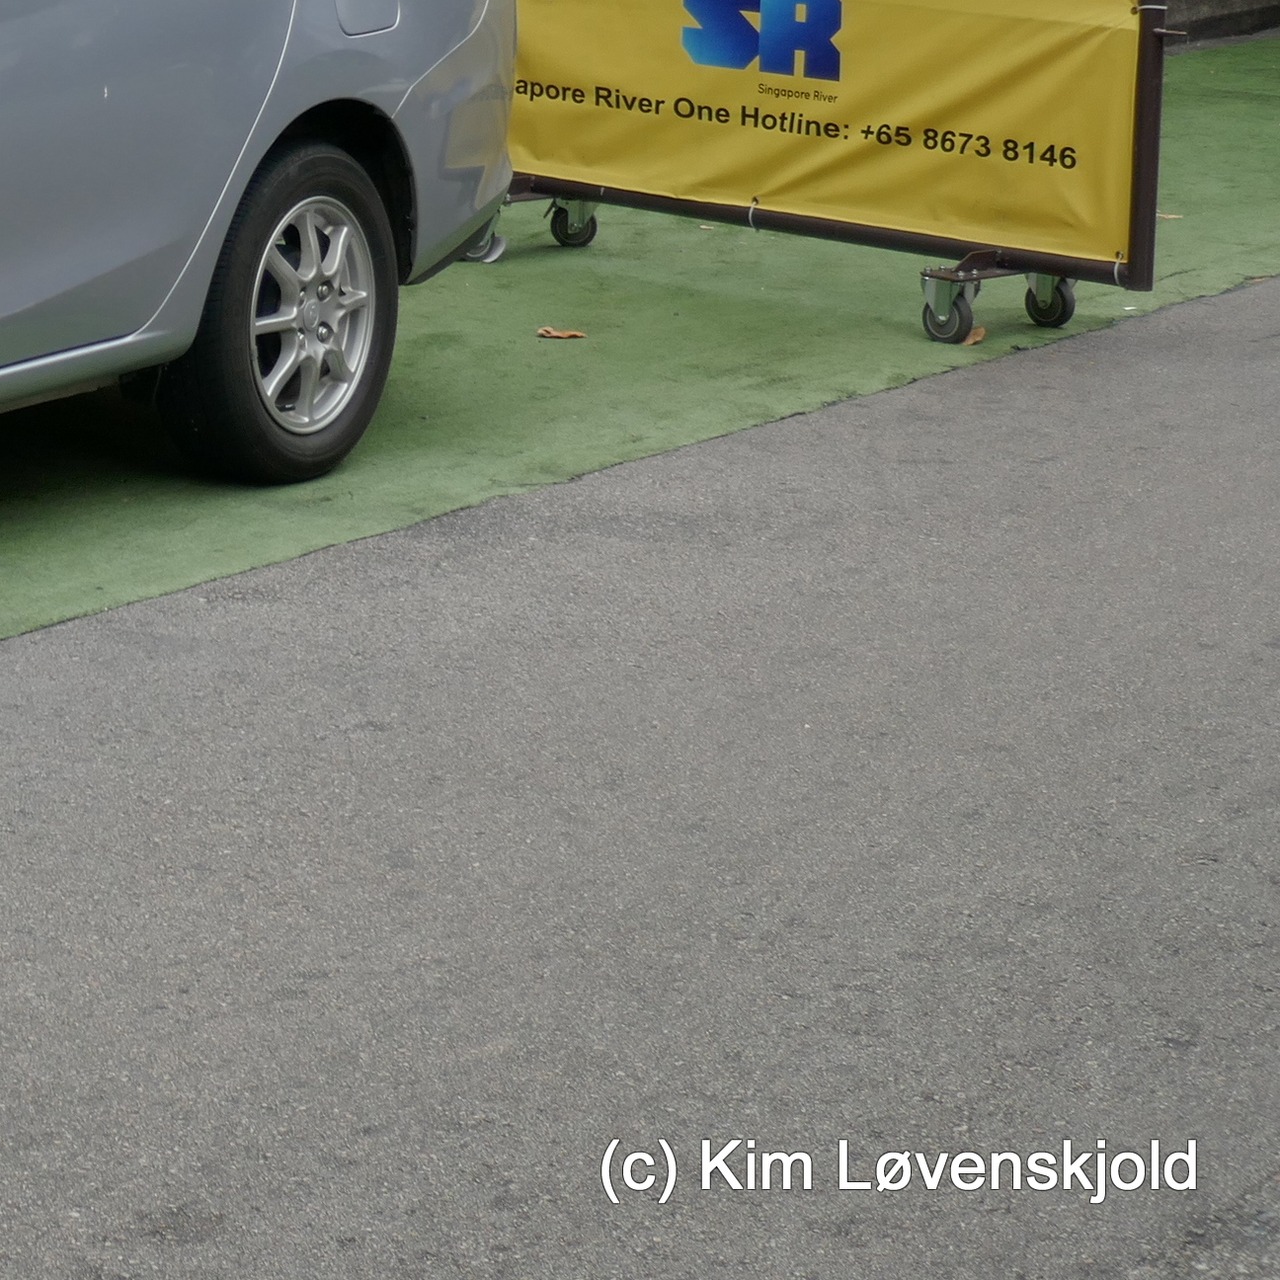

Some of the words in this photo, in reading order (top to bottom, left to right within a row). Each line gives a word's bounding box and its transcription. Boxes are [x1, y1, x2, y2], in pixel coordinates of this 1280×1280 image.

[758, 83, 811, 101] Singapore
[813, 91, 839, 104] River
[515, 78, 586, 104] apore
[594, 86, 665, 115] River
[673, 97, 731, 124] One
[740, 105, 850, 140] Hotline:
[860, 123, 913, 149] +65
[922, 129, 993, 159] 8673
[1002, 138, 1078, 170] 8146
